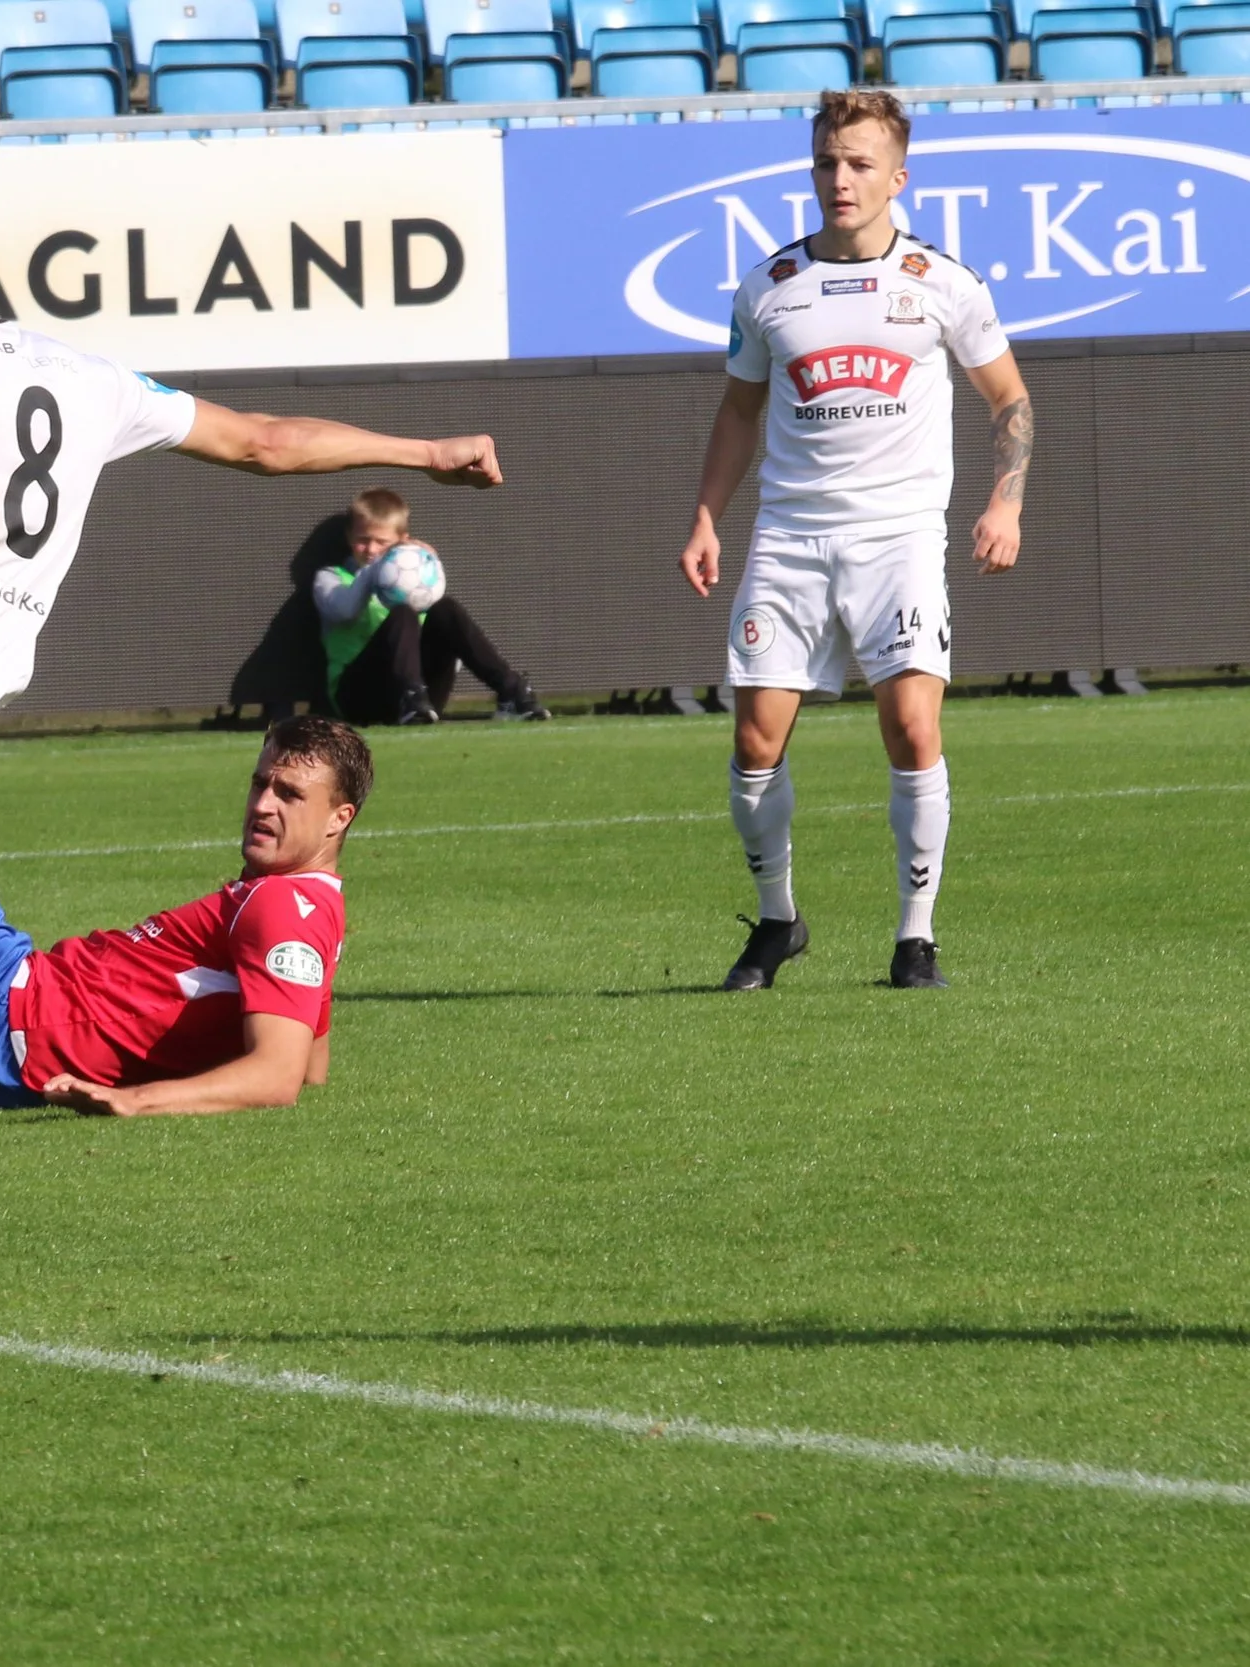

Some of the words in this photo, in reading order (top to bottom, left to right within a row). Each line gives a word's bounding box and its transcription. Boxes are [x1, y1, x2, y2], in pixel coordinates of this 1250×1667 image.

[714, 178, 1207, 291] NT.Kai
[799, 355, 901, 390] MENY
[795, 401, 907, 421] BORREVEIEN
[4, 385, 63, 560] 8
[743, 619, 760, 645] B
[896, 606, 923, 636] 14
